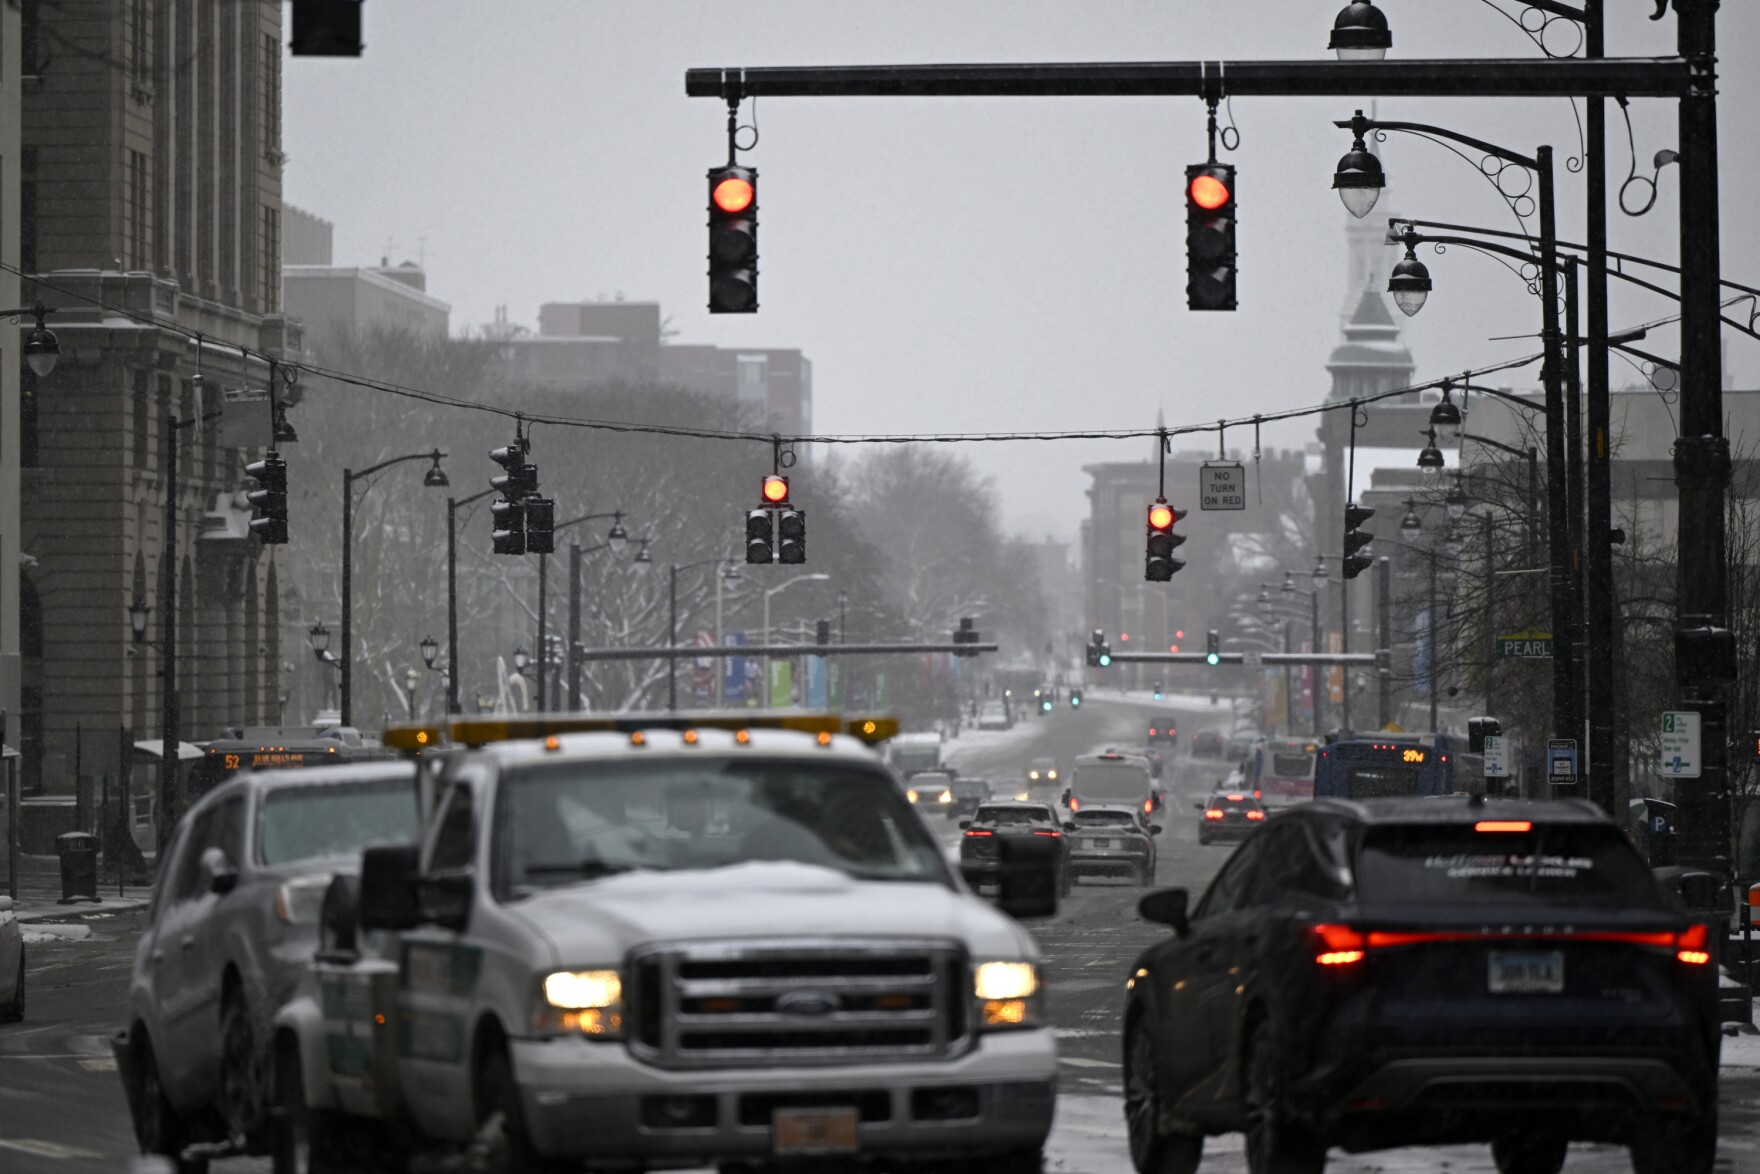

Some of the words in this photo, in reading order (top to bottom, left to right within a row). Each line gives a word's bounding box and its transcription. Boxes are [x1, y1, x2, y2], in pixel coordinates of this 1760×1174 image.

[1214, 471, 1230, 481] NO
[1210, 484, 1236, 493] TURN
[1204, 496, 1218, 505] ON
[1222, 496, 1241, 505] RED
[1504, 641, 1551, 656] PEARL
[1665, 715, 1672, 732] 2
[225, 754, 240, 769] 52
[1655, 816, 1665, 832] P
